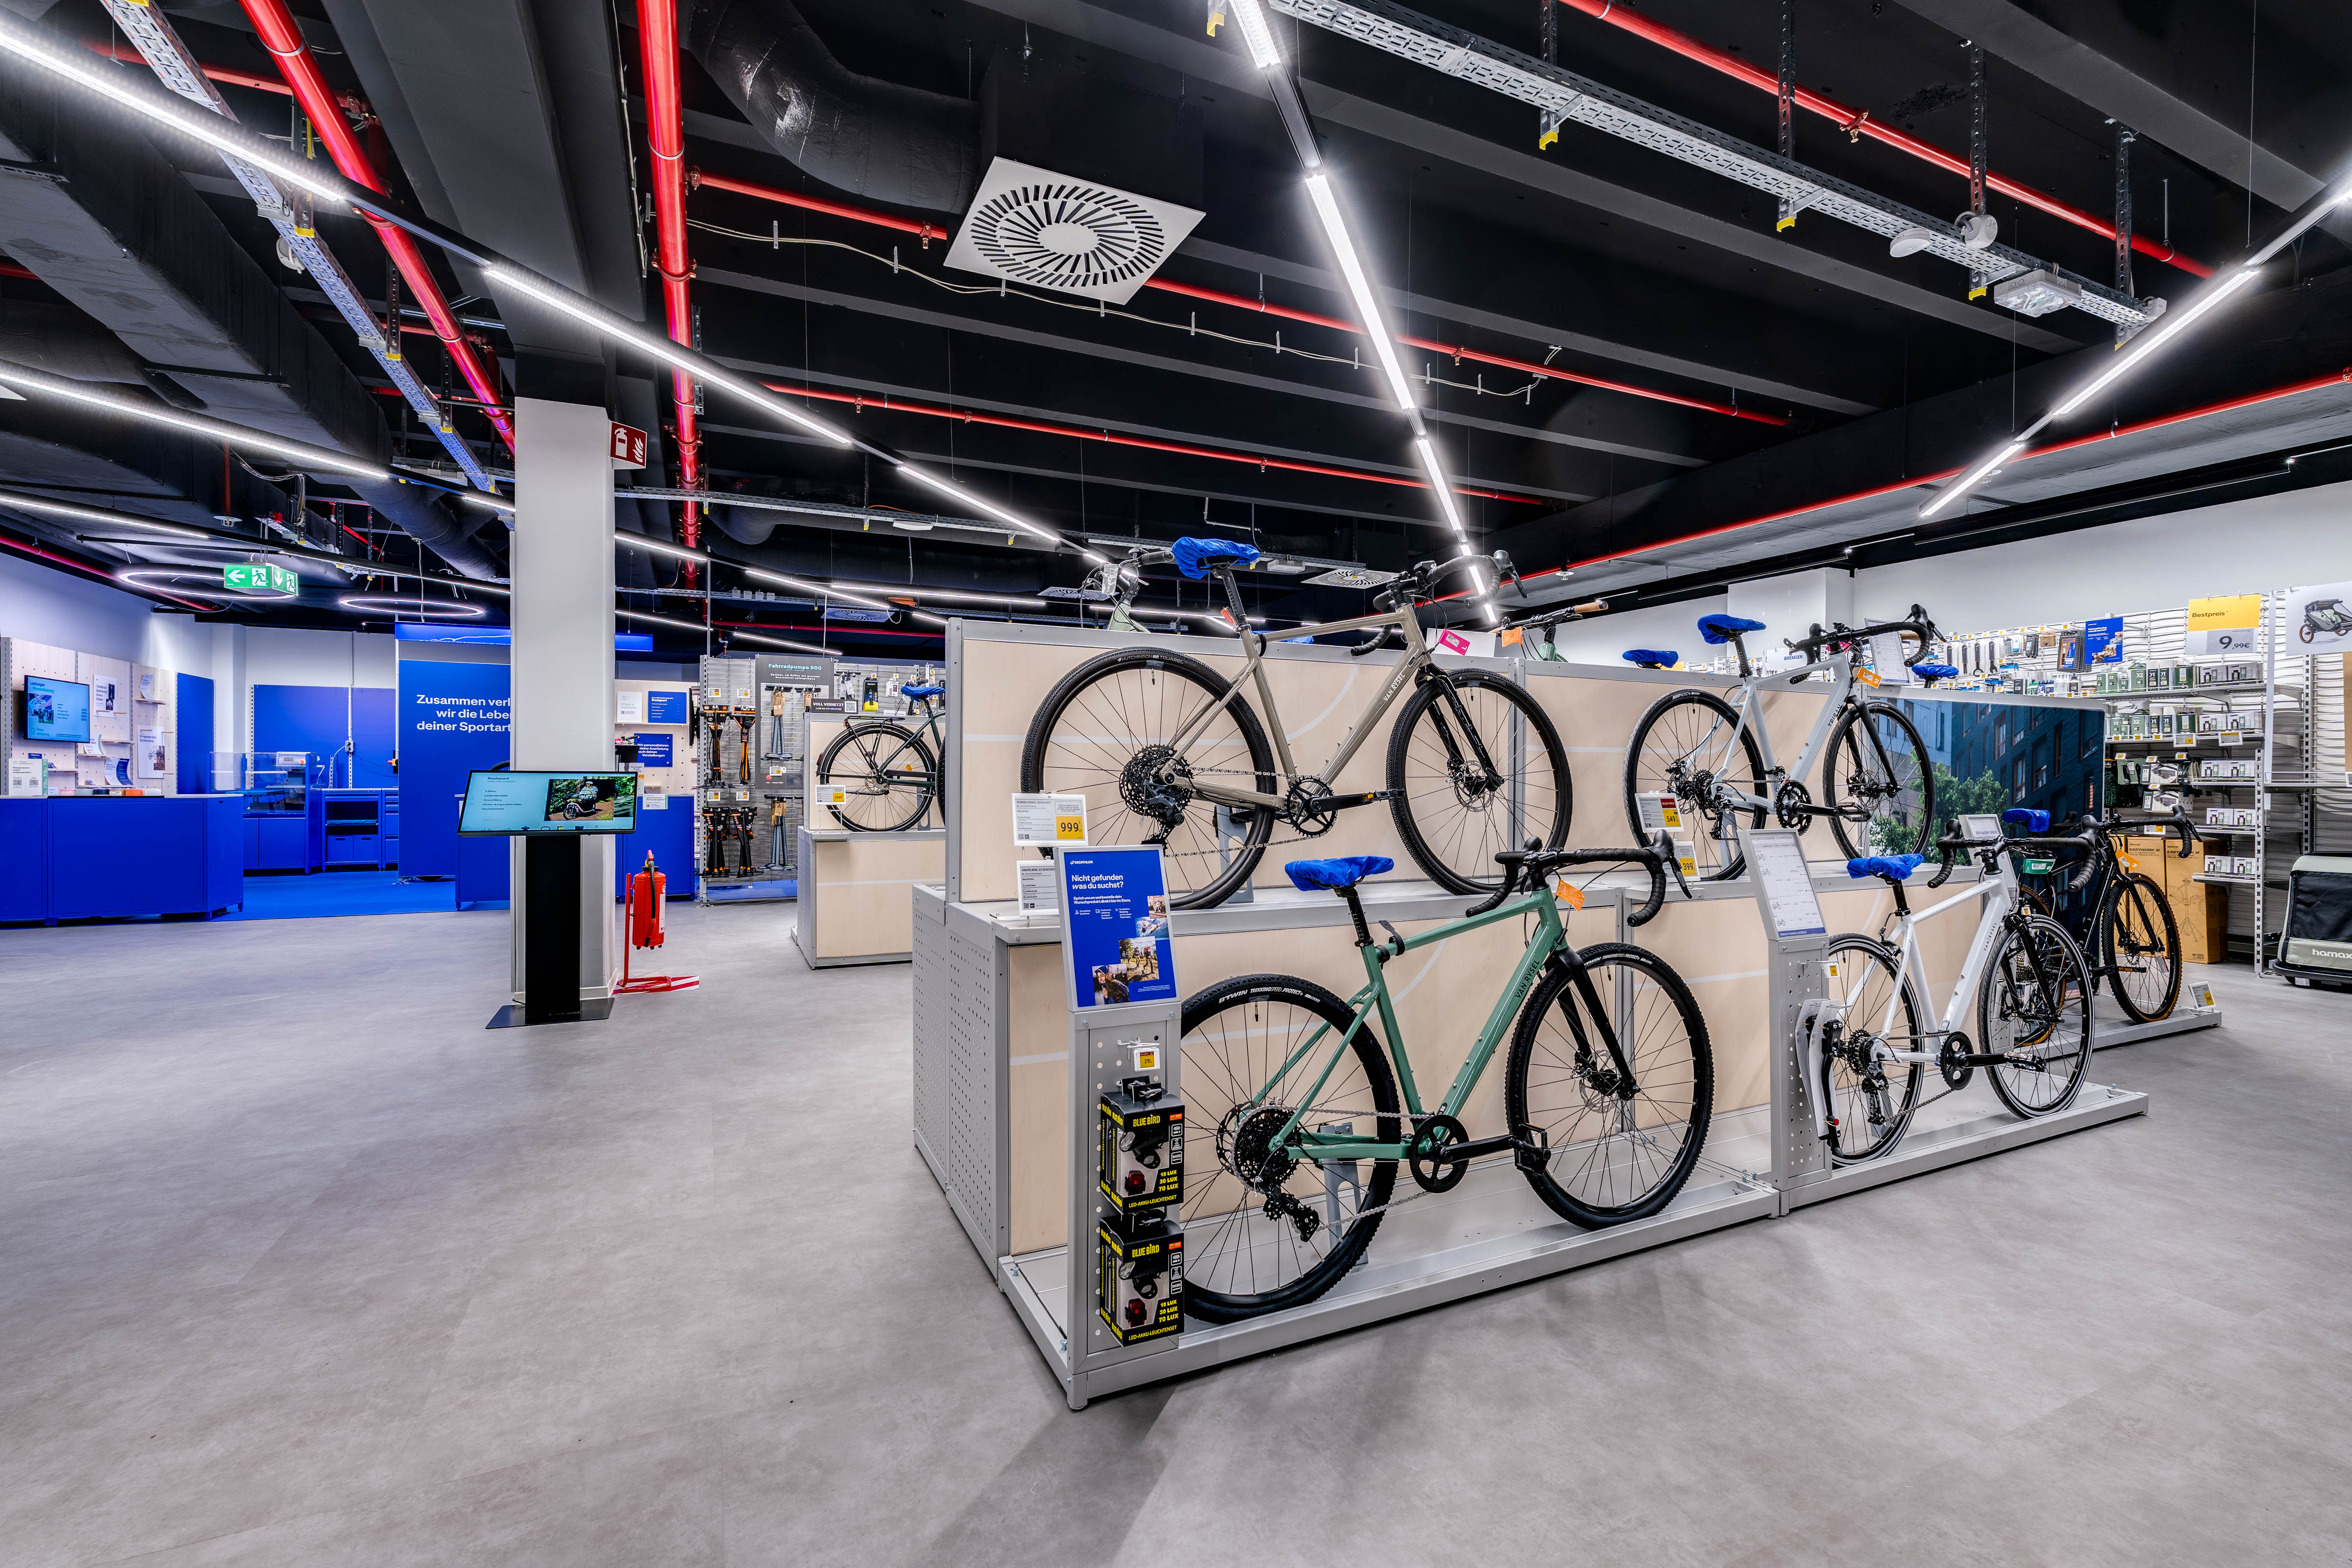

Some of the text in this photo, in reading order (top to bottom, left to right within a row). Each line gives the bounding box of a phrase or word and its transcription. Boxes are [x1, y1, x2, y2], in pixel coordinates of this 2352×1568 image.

[2219, 636, 2250, 649] 9,99€
[1383, 673, 1406, 702] VAN RYSEL
[416, 694, 486, 706] Zusammen
[436, 709, 511, 719] wir die Lebe
[416, 721, 511, 733] deiner Sportart
[1061, 822, 1078, 832] 999
[2312, 948, 2352, 959] hamax
[1515, 960, 1540, 998] VAN RYSEL
[1282, 987, 1303, 996] PROTECT+
[1133, 1117, 1147, 1127] BLUE
[1147, 1114, 1160, 1125] BIRD
[1128, 1195, 1177, 1208] LED-AKKU-LEUCHTENSET
[1132, 1244, 1159, 1258] BLUE BIRD
[1128, 1325, 1177, 1341] LED-AKKU-LEUCHTENSET
